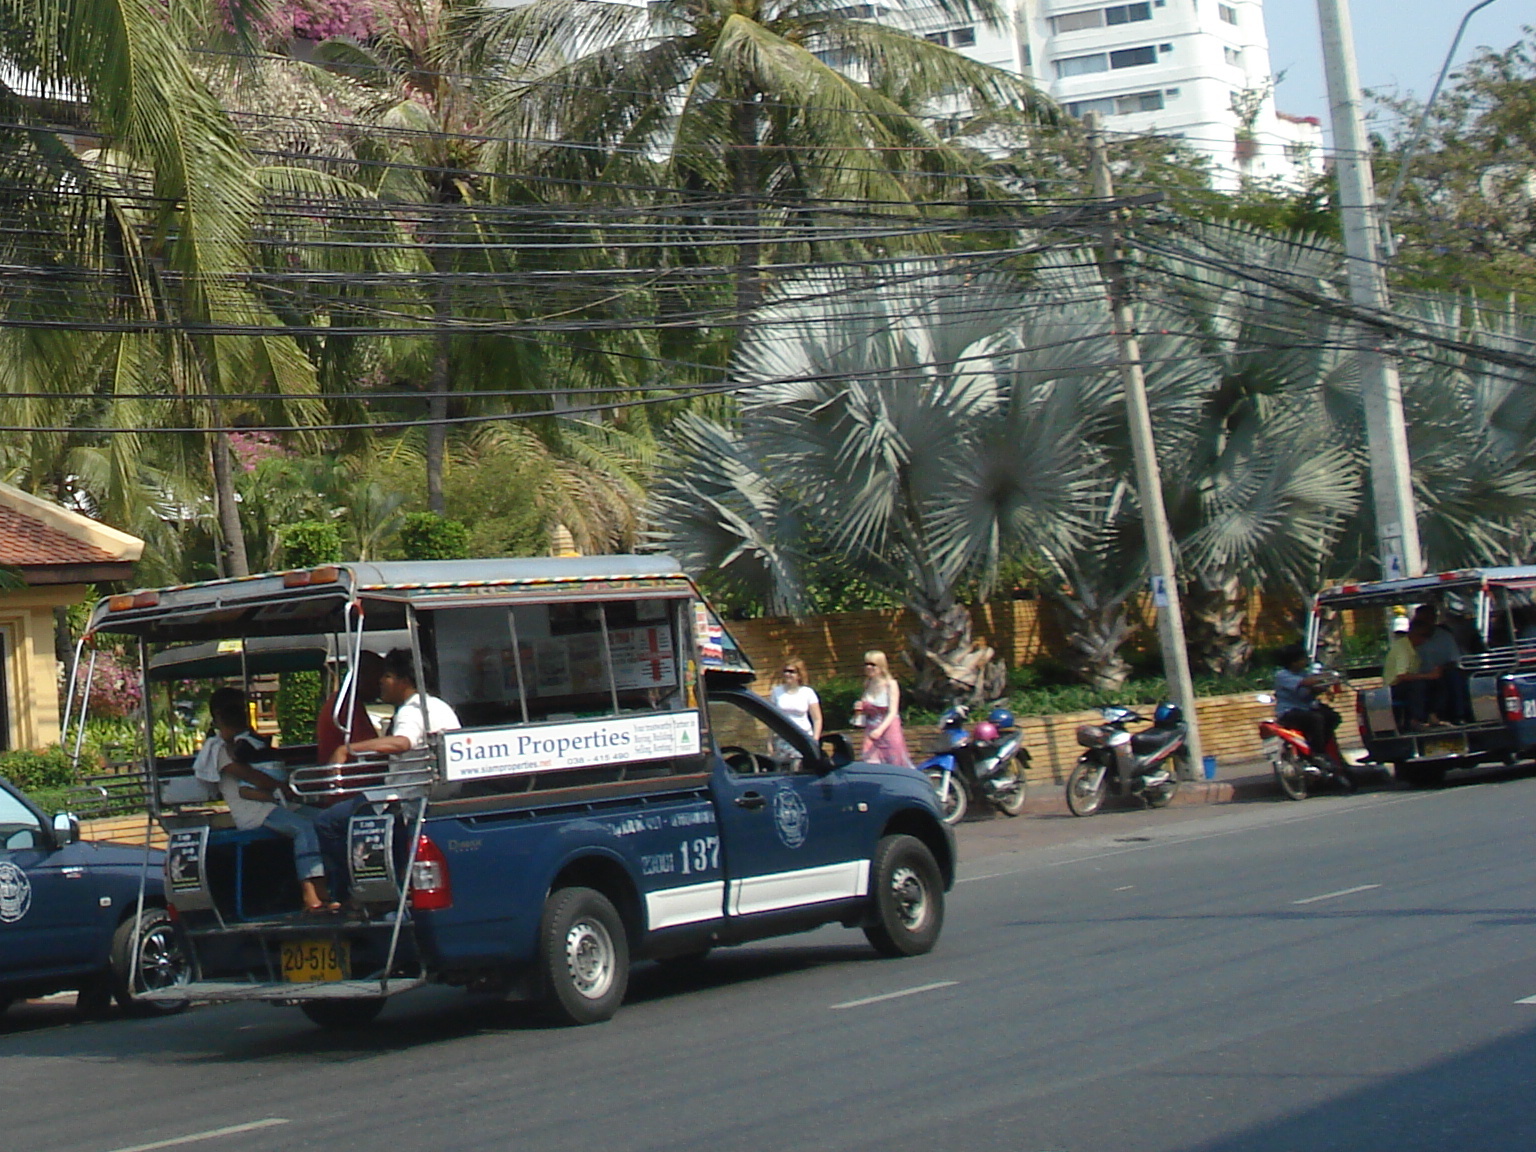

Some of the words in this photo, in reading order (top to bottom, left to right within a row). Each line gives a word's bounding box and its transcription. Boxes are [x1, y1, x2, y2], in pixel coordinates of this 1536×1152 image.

[449, 737, 509, 762] Siam
[517, 728, 630, 758] Properties
[459, 759, 552, 776] www.siamproperties.net
[566, 757, 585, 766] 038
[594, 754, 610, 764] 415
[680, 836, 720, 874] 137
[284, 946, 346, 971] 20-519
